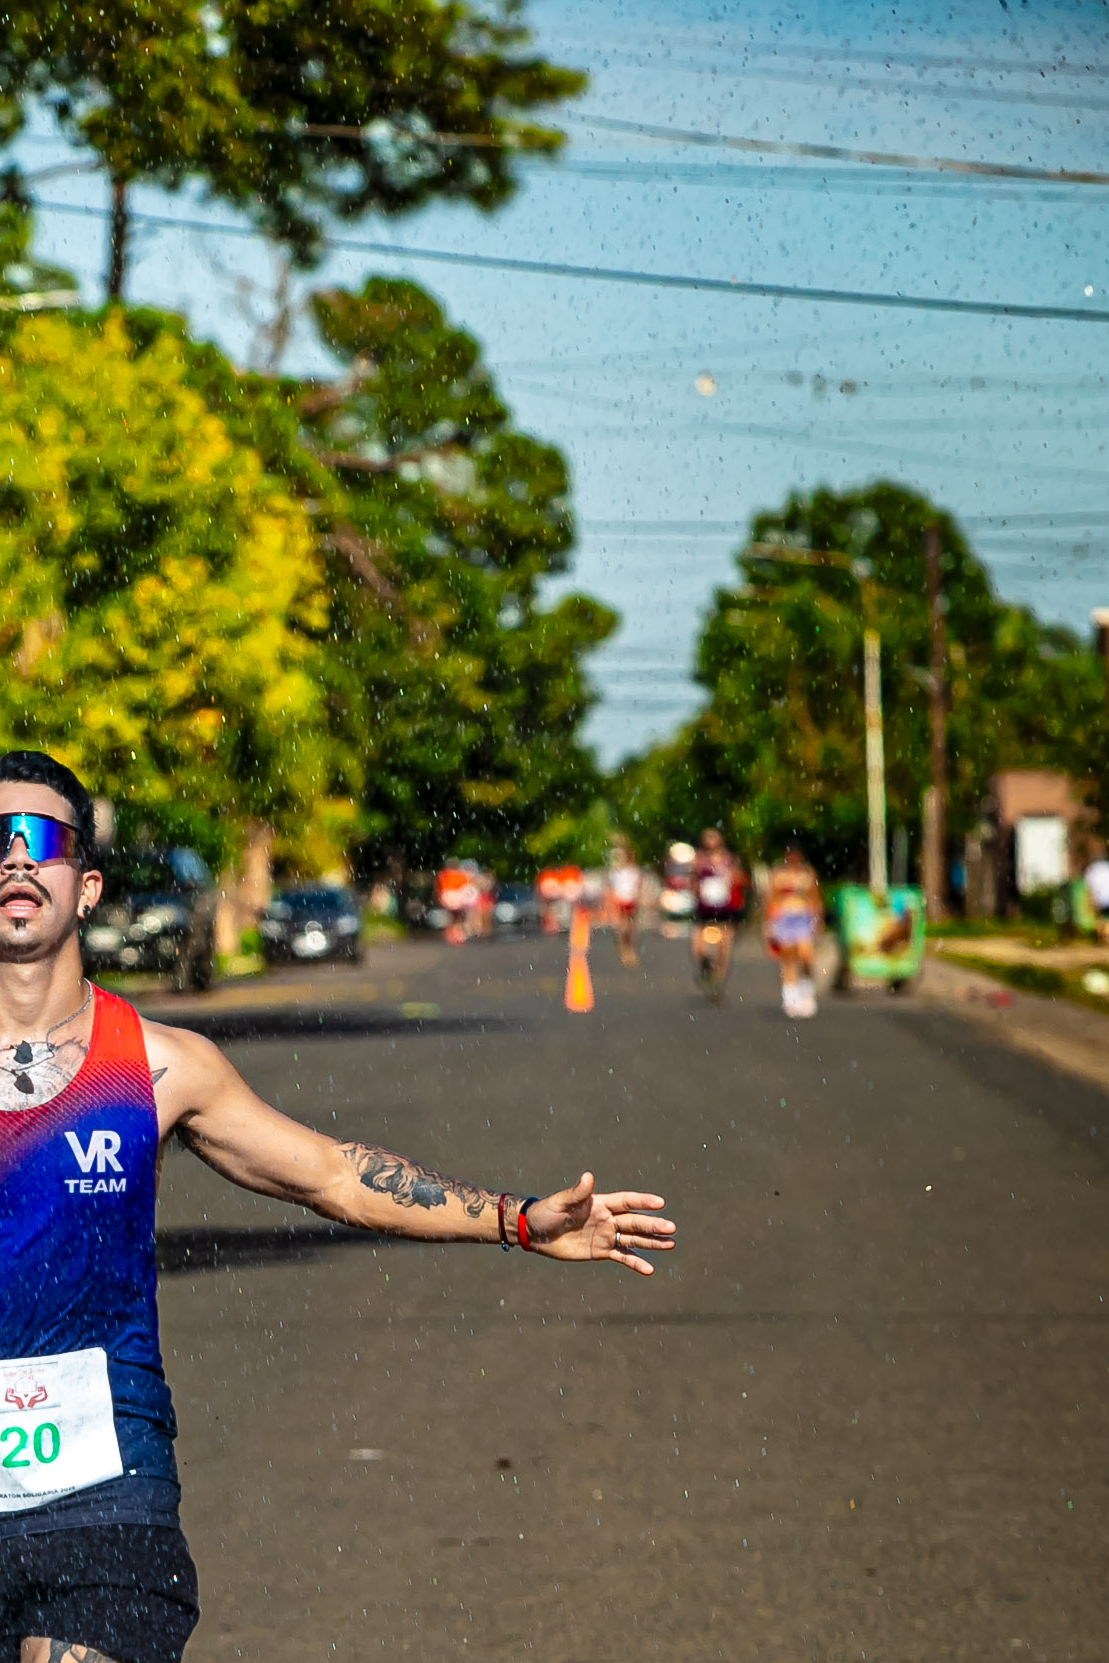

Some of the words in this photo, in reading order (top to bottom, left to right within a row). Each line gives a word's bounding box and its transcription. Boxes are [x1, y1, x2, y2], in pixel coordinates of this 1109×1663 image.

[64, 1130, 124, 1173] VR
[64, 1178, 127, 1194] TEAM
[0, 1422, 60, 1468] 20
